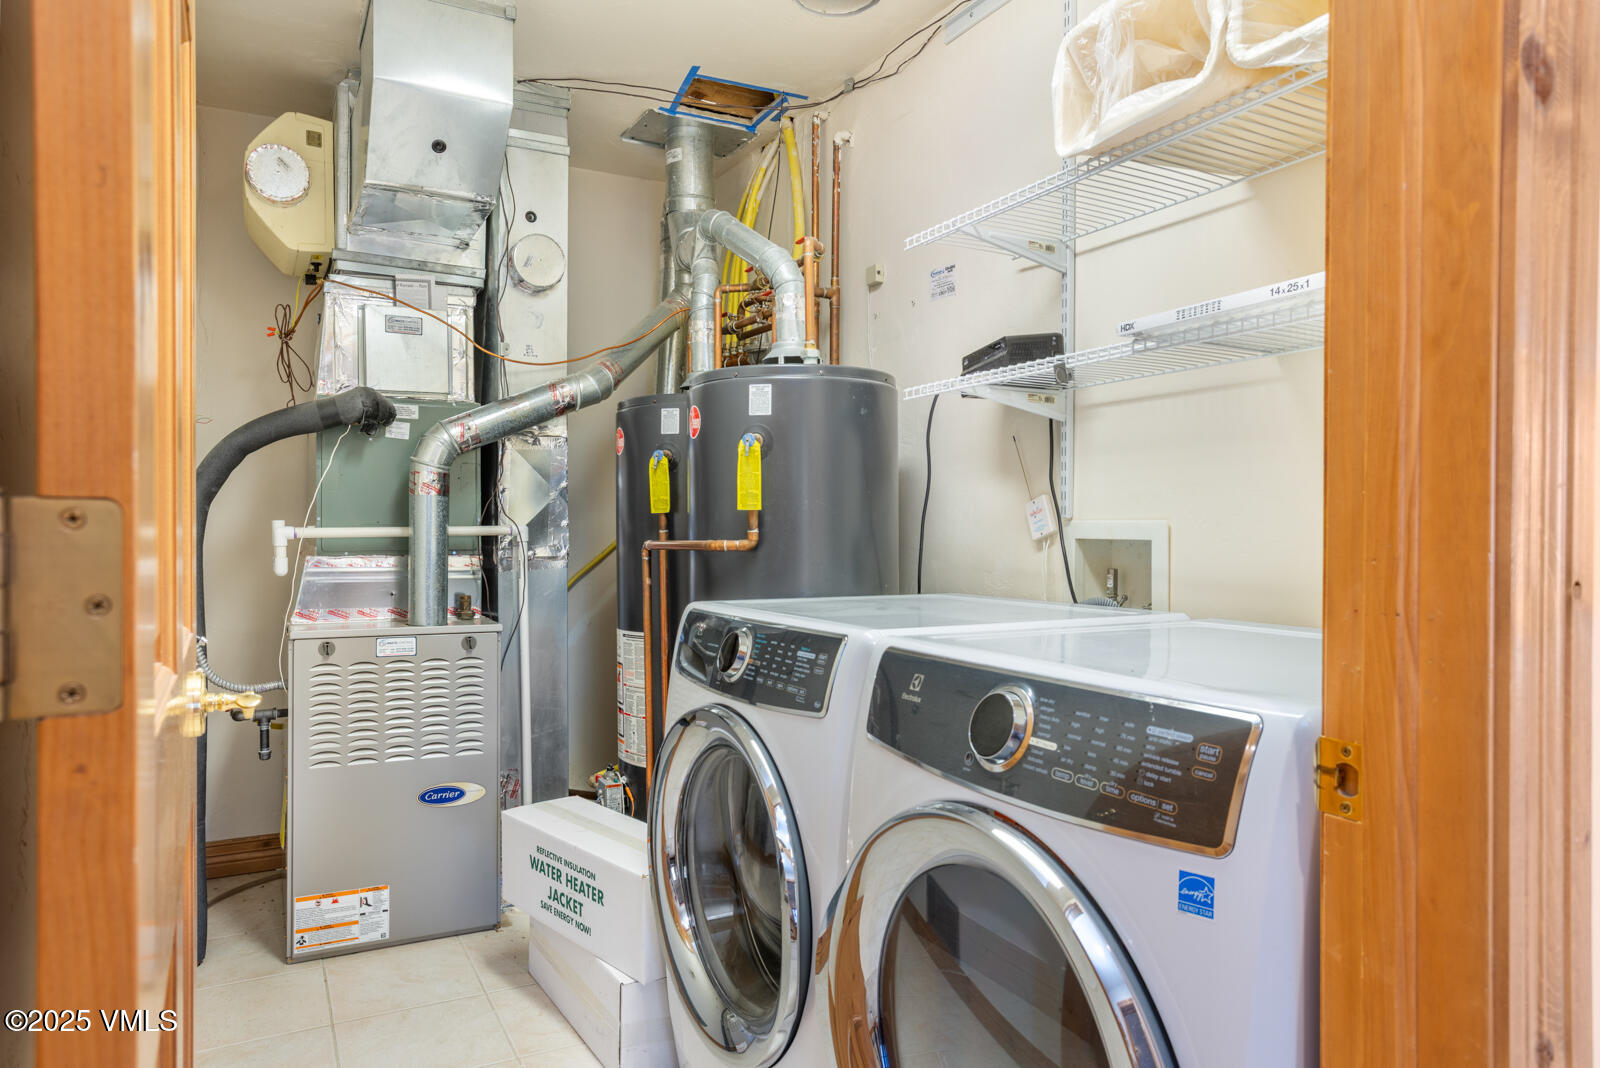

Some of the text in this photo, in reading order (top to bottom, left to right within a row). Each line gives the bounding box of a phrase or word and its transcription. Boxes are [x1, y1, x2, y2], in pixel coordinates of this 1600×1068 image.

[1120, 322, 1136, 333] HDX
[1200, 745, 1220, 756] start
[425, 790, 461, 801] Carrier
[1130, 794, 1157, 806] options
[536, 845, 596, 881] REFLECTIVE INSULATION
[529, 854, 605, 907] WATER HEATER
[547, 886, 584, 917] JACKET
[540, 899, 592, 937] SAVE ENERGY NOW!
